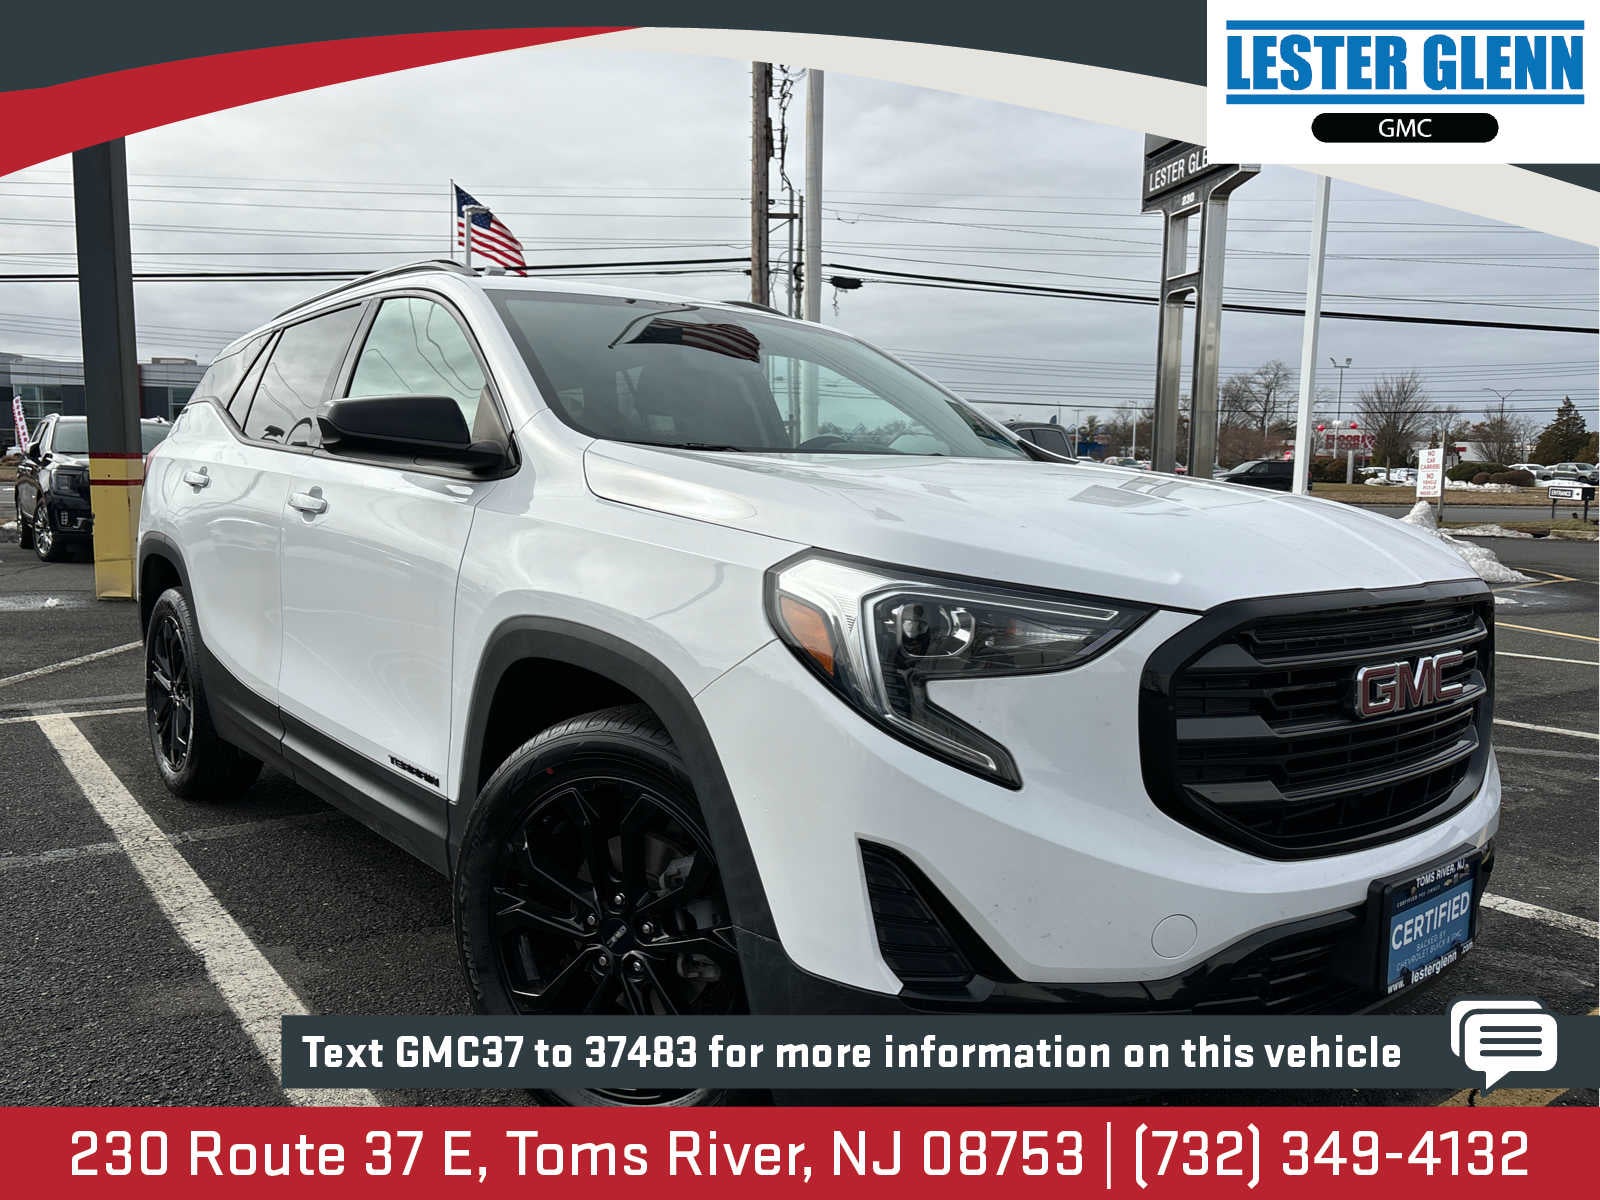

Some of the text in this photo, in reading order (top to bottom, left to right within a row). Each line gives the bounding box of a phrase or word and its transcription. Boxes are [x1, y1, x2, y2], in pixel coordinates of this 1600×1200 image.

[1148, 147, 1208, 193] LESTER GLE
[1181, 192, 1195, 206] 230
[1356, 650, 1464, 717] GMC
[388, 754, 440, 788] TERRAIN
[1416, 872, 1435, 888] TOMS
[1456, 857, 1465, 871] NJ
[1391, 891, 1470, 950] CERTIFIED
[1416, 933, 1438, 952] BACKED
[1411, 951, 1457, 984] lesterglenn
